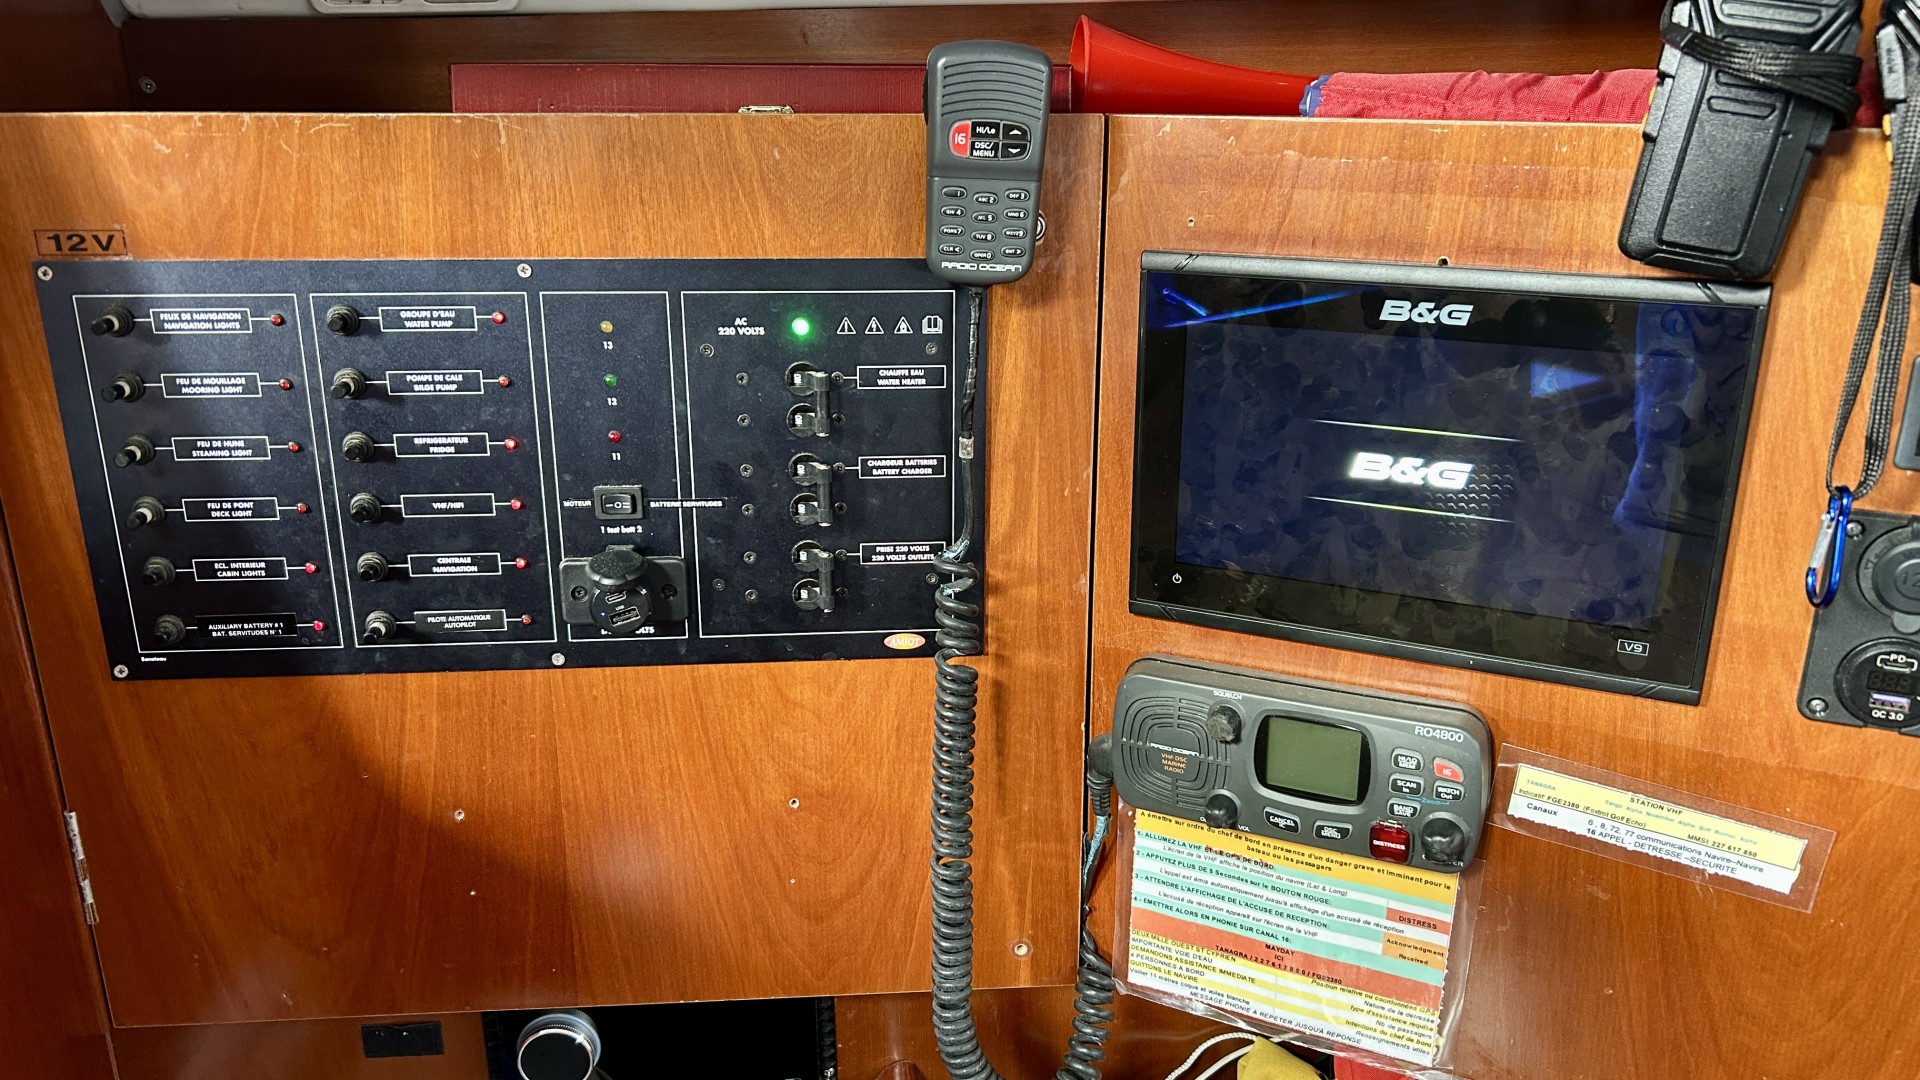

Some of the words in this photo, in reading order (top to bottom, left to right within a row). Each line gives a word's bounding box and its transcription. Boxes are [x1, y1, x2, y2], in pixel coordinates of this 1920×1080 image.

[955, 133, 966, 144] 16
[1379, 300, 1474, 326] B&G
[734, 317, 747, 326] AC
[718, 327, 736, 336] 220
[737, 327, 765, 335] VOLTS
[603, 341, 613, 350] 13
[607, 398, 617, 406] 12
[1350, 452, 1474, 490] B&G
[1624, 642, 1643, 652] V9
[1890, 654, 1907, 663] PD
[1213, 690, 1242, 700] SQUELCH
[1871, 709, 1887, 718] QC
[1161, 760, 1187, 769] MARINE
[1164, 766, 1184, 774] RADIO
[1396, 780, 1417, 788] SCAN
[1437, 786, 1459, 795] WATCH
[1526, 779, 1556, 791] TANAGRA
[1526, 802, 1558, 816] Canaux
[1547, 796, 1580, 809] FGE2380
[1610, 813, 1625, 822] Golf
[1626, 817, 1646, 828] Echo)
[1629, 796, 1664, 811] STATION
[1667, 807, 1683, 816] VHF
[1145, 832, 1176, 845] ALLUMEZ
[1373, 840, 1406, 850] DISTRESS
[1597, 830, 1625, 845] APPEL
[1633, 841, 1682, 859] DETRESSE
[1636, 834, 1701, 856] communications
[1711, 841, 1726, 849] 227
[1728, 845, 1742, 853] 617
[1743, 849, 1758, 858] 850
[1246, 845, 1270, 857] bateau
[1295, 858, 1332, 872] passagers
[1146, 852, 1176, 866] APPUYEZ
[1178, 860, 1196, 870] PLUS
[1215, 870, 1249, 883] Secondes
[1271, 885, 1302, 898] BOUTON
[1325, 856, 1352, 868] danger
[1353, 862, 1375, 872] grave
[1386, 870, 1423, 884] imminent
[1144, 875, 1179, 890] ATTENDRE
[1143, 898, 1174, 912] EMETTRE
[1175, 907, 1199, 918] ALORS
[1212, 916, 1238, 928] PHONIE
[1255, 929, 1279, 940] CANAL
[1398, 915, 1437, 930] DISTRESS
[1215, 945, 1248, 960] TANAGRA
[1265, 943, 1295, 956] MAYDAY
[1386, 938, 1444, 957] Acknowledgment
[1131, 945, 1173, 961] DEMANDONS
[1174, 957, 1217, 973] ASSISTANCE
[1218, 969, 1256, 984] IMMEDIATE
[1135, 953, 1177, 969] PERSONNES
[1185, 966, 1205, 977] BORD
[1398, 953, 1429, 965] Received
[1130, 960, 1162, 974] QUITTONS
